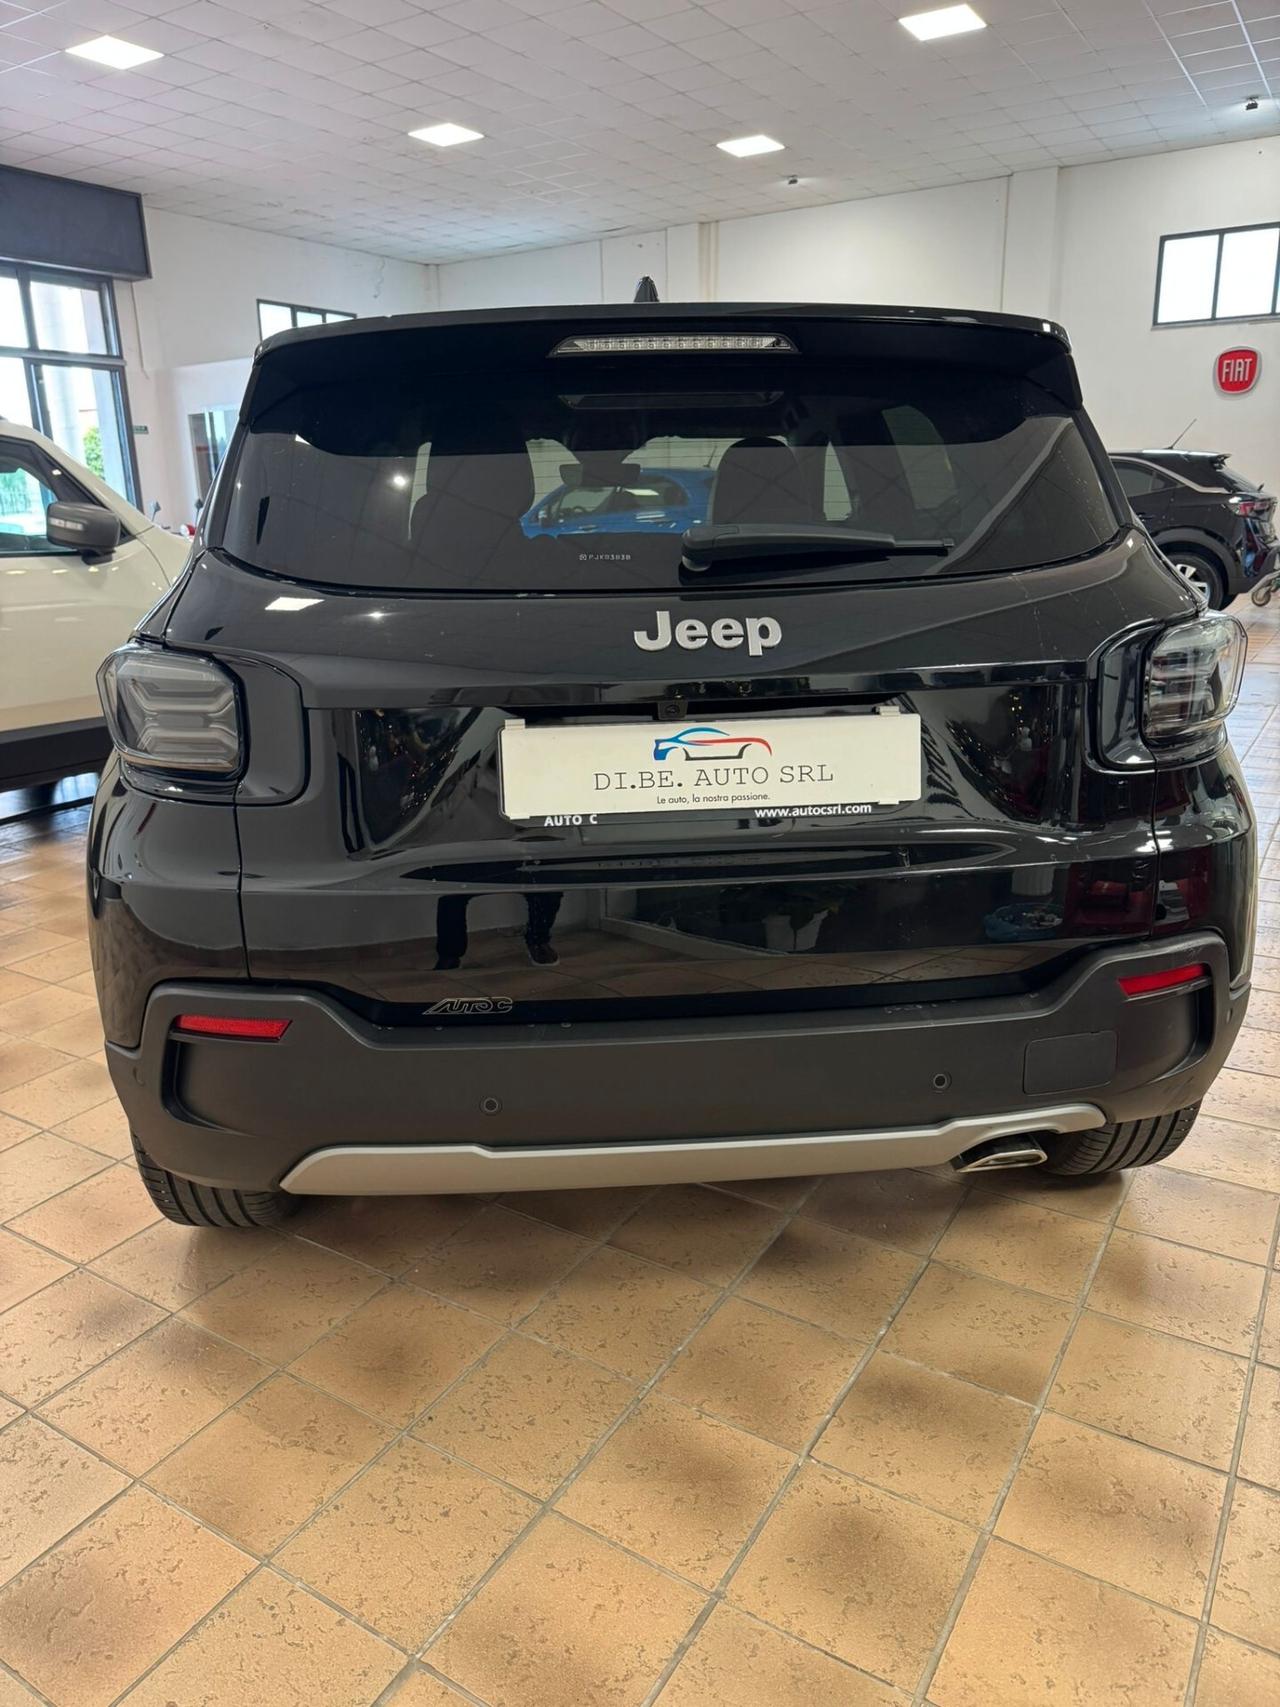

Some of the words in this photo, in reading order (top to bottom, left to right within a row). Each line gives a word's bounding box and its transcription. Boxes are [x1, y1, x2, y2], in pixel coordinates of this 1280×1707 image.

[1222, 358, 1253, 382] FIAT
[633, 610, 782, 656] Jeep
[593, 770, 683, 791] DI.BE.
[693, 766, 769, 787] AUTO
[780, 764, 834, 784] SRL
[656, 795, 667, 805] Le
[668, 795, 690, 805] auto,
[692, 793, 701, 803] la
[702, 793, 729, 803] nostra
[731, 791, 771, 804] passione.
[543, 814, 583, 827] AUTO
[588, 813, 599, 825] C
[754, 803, 873, 819] www.autocsrl.com
